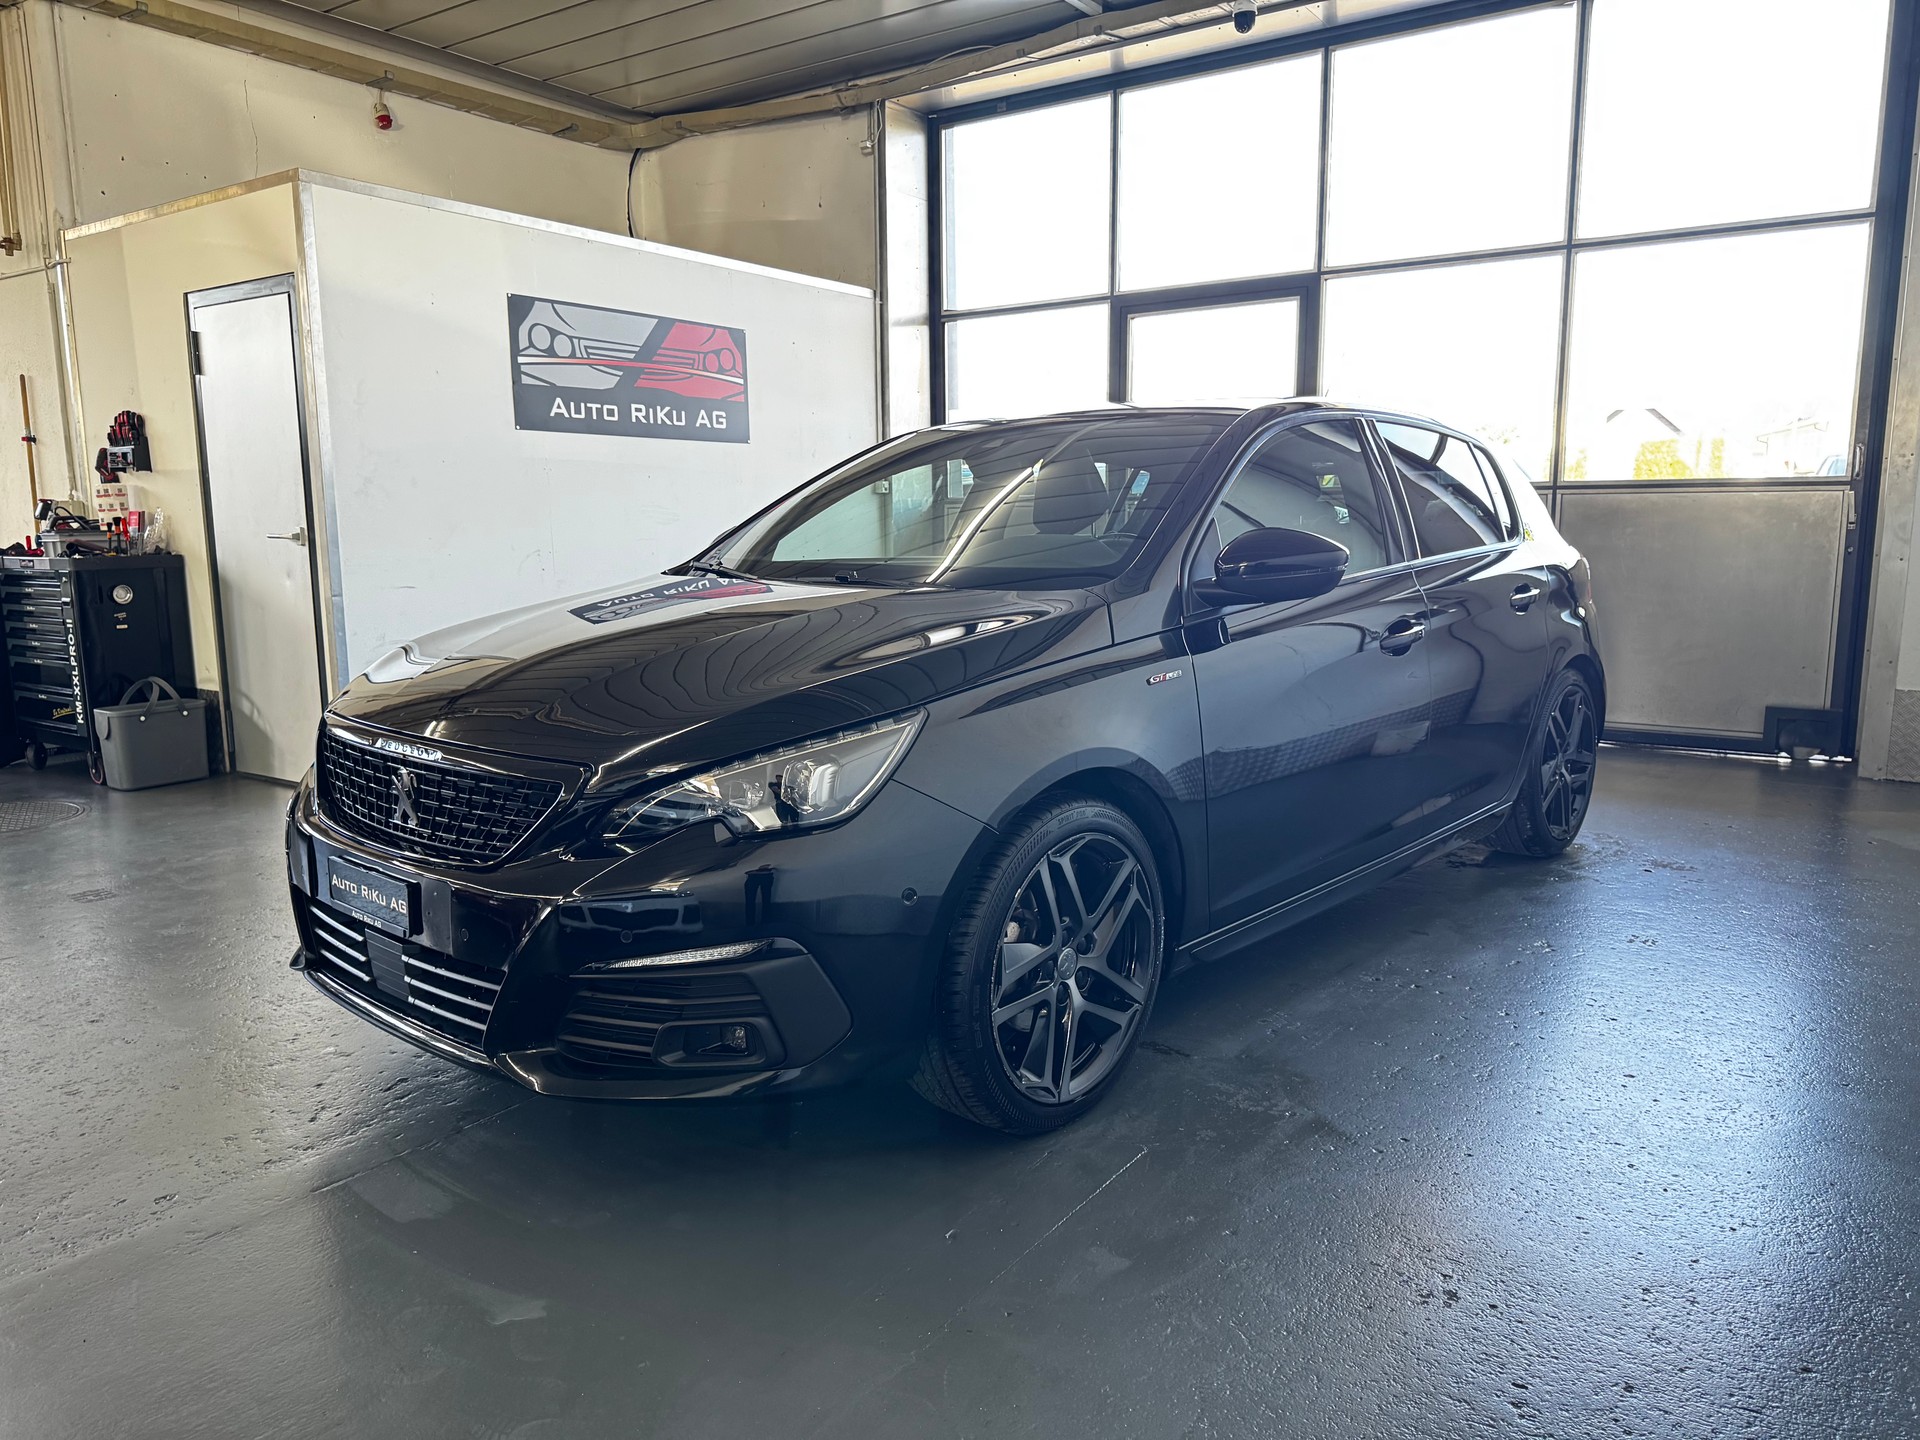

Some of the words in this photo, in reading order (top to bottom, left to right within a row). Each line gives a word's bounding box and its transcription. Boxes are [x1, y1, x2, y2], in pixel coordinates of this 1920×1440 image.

[550, 398, 619, 421] AUTO
[696, 410, 727, 429] AG
[332, 874, 358, 895] AUTO
[390, 897, 407, 914] AG
